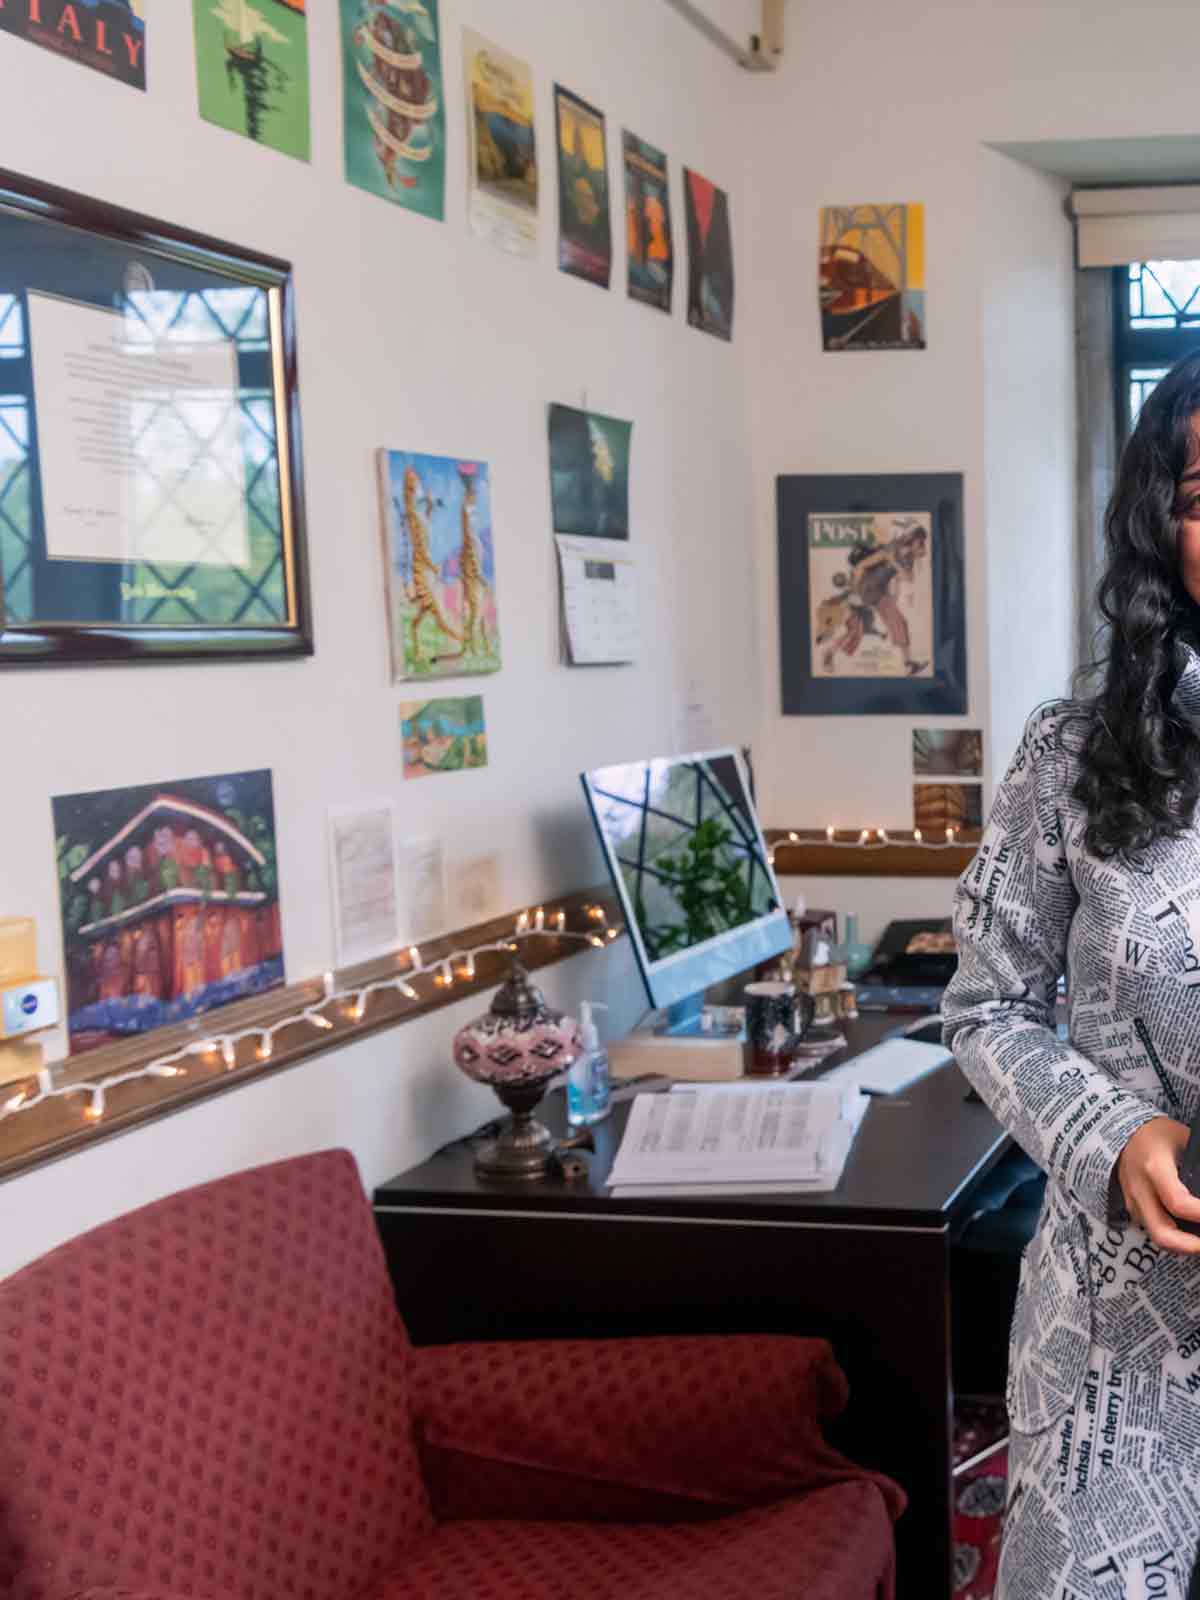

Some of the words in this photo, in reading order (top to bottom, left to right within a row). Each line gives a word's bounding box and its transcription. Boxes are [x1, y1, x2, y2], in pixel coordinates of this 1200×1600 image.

[0, 0, 143, 68] TALY
[1063, 1101, 1088, 1133] chief
[1087, 1092, 1099, 1105] is
[1088, 1370, 1099, 1380] a
[1084, 1385, 1098, 1414] and
[1101, 1392, 1121, 1444] cherry
